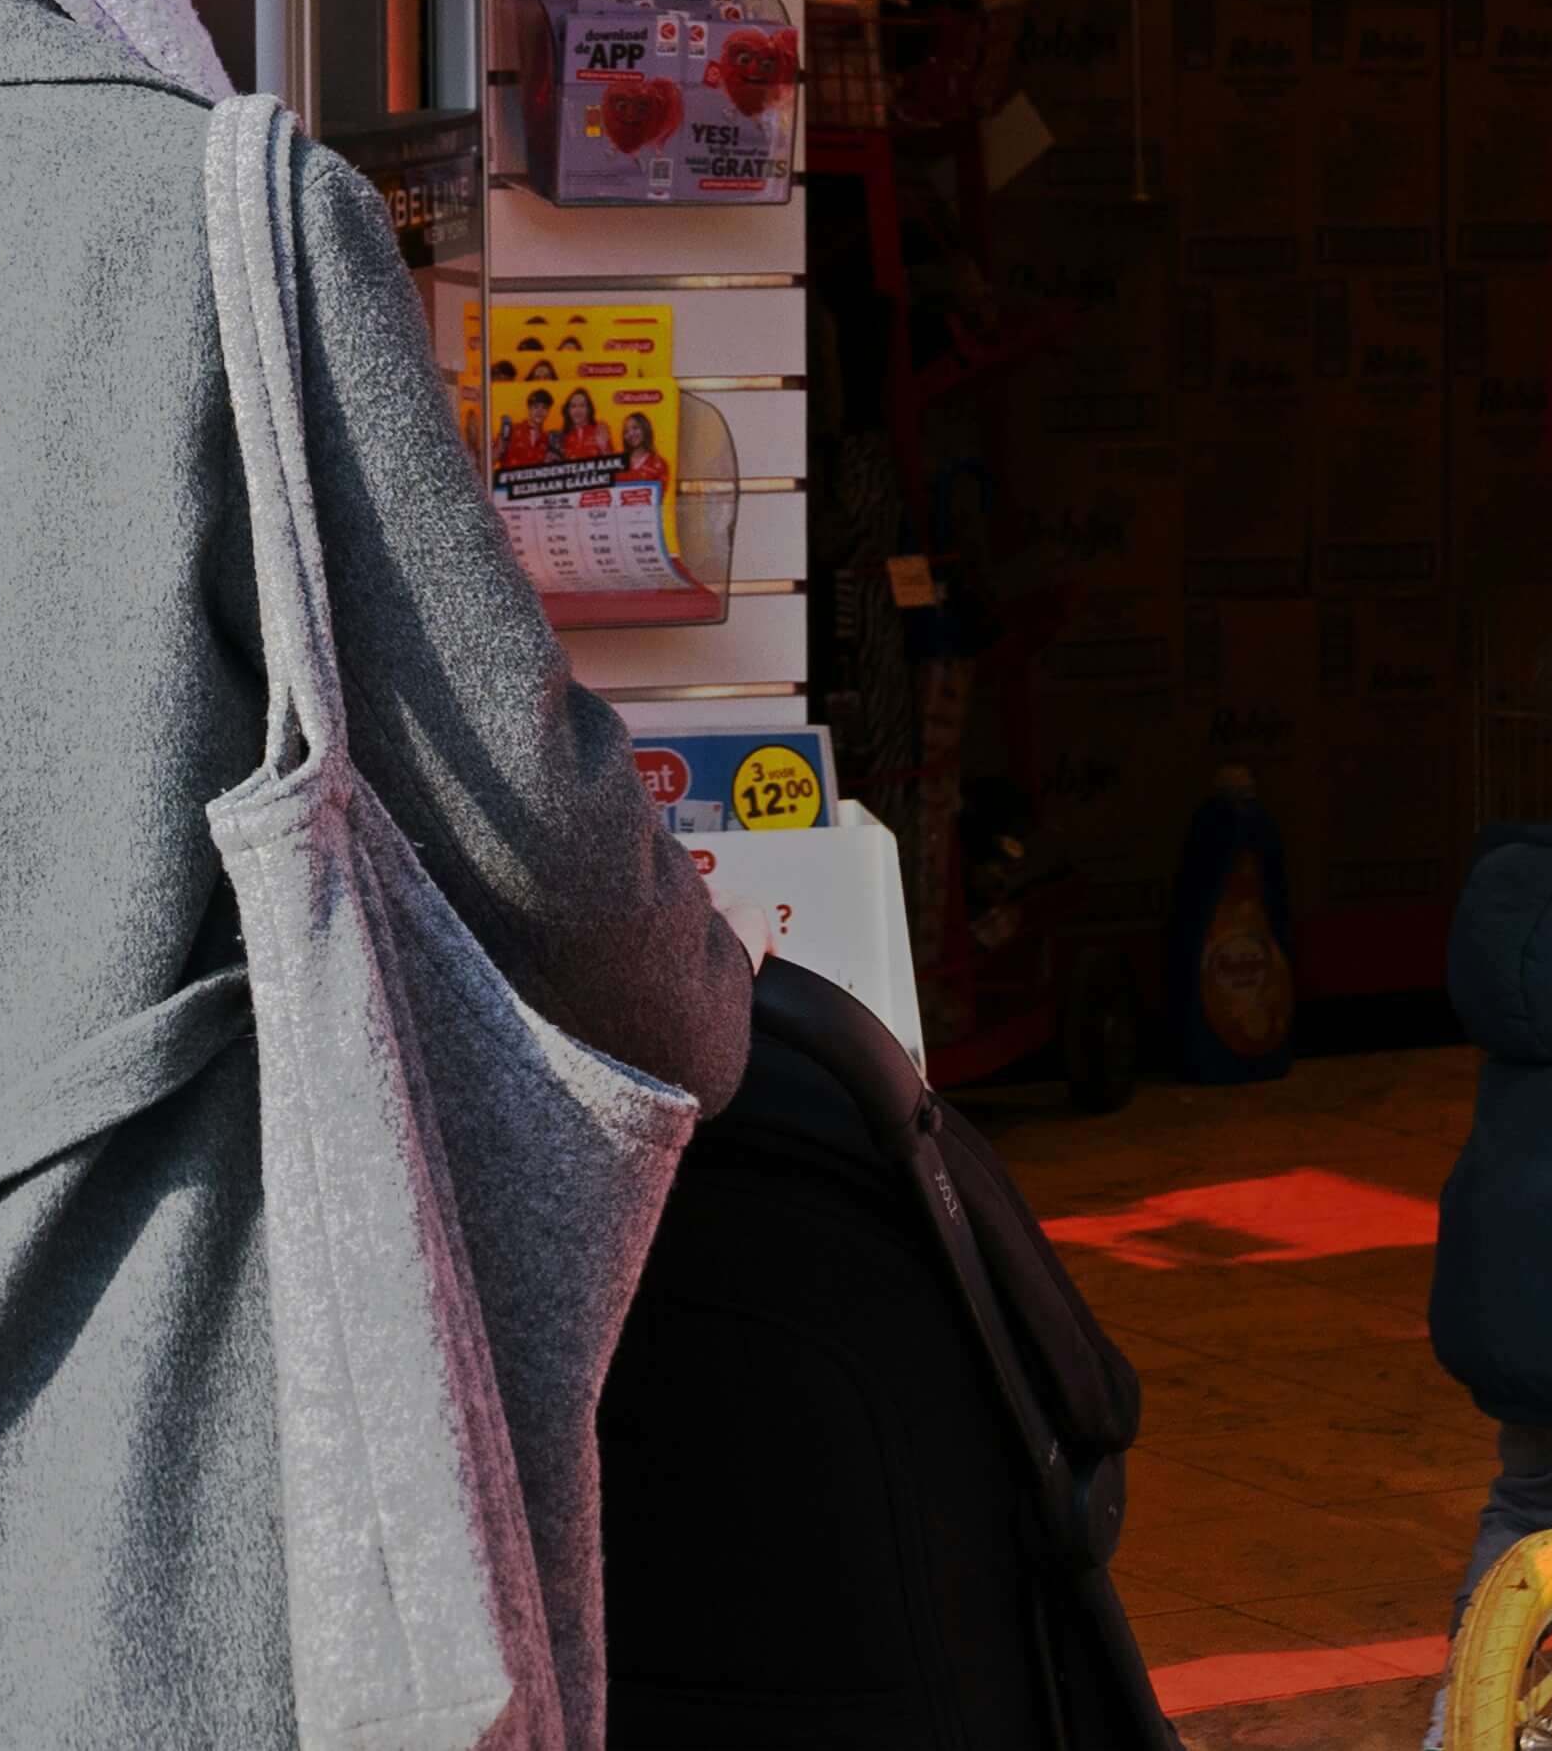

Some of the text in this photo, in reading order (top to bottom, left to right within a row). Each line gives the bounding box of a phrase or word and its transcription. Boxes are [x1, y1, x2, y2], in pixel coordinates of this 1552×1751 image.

[585, 29, 647, 42] download
[588, 44, 645, 69] APP
[692, 123, 740, 146] YES!
[751, 762, 766, 782] 3
[741, 778, 814, 819] 12.00
